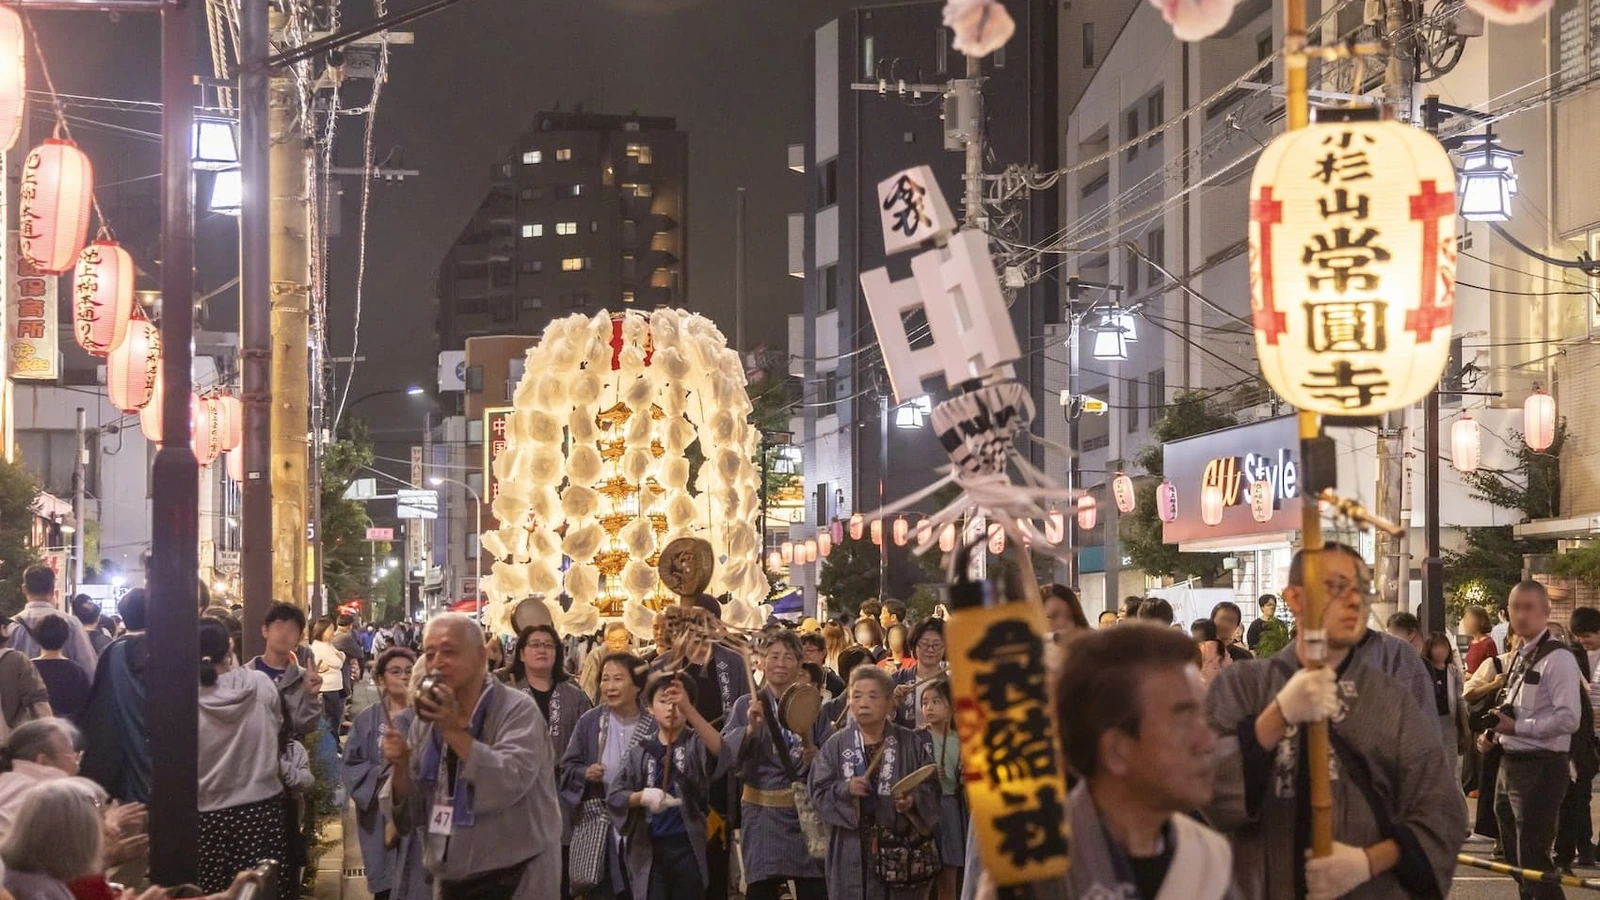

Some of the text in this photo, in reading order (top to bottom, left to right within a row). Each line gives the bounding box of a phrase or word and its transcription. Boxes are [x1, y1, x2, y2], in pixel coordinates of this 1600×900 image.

[75, 249, 105, 349] 池上柳本通り会
[1301, 132, 1391, 408] 小杉山常圓寺
[1243, 448, 1297, 506] Style
[433, 812, 451, 827] 47
